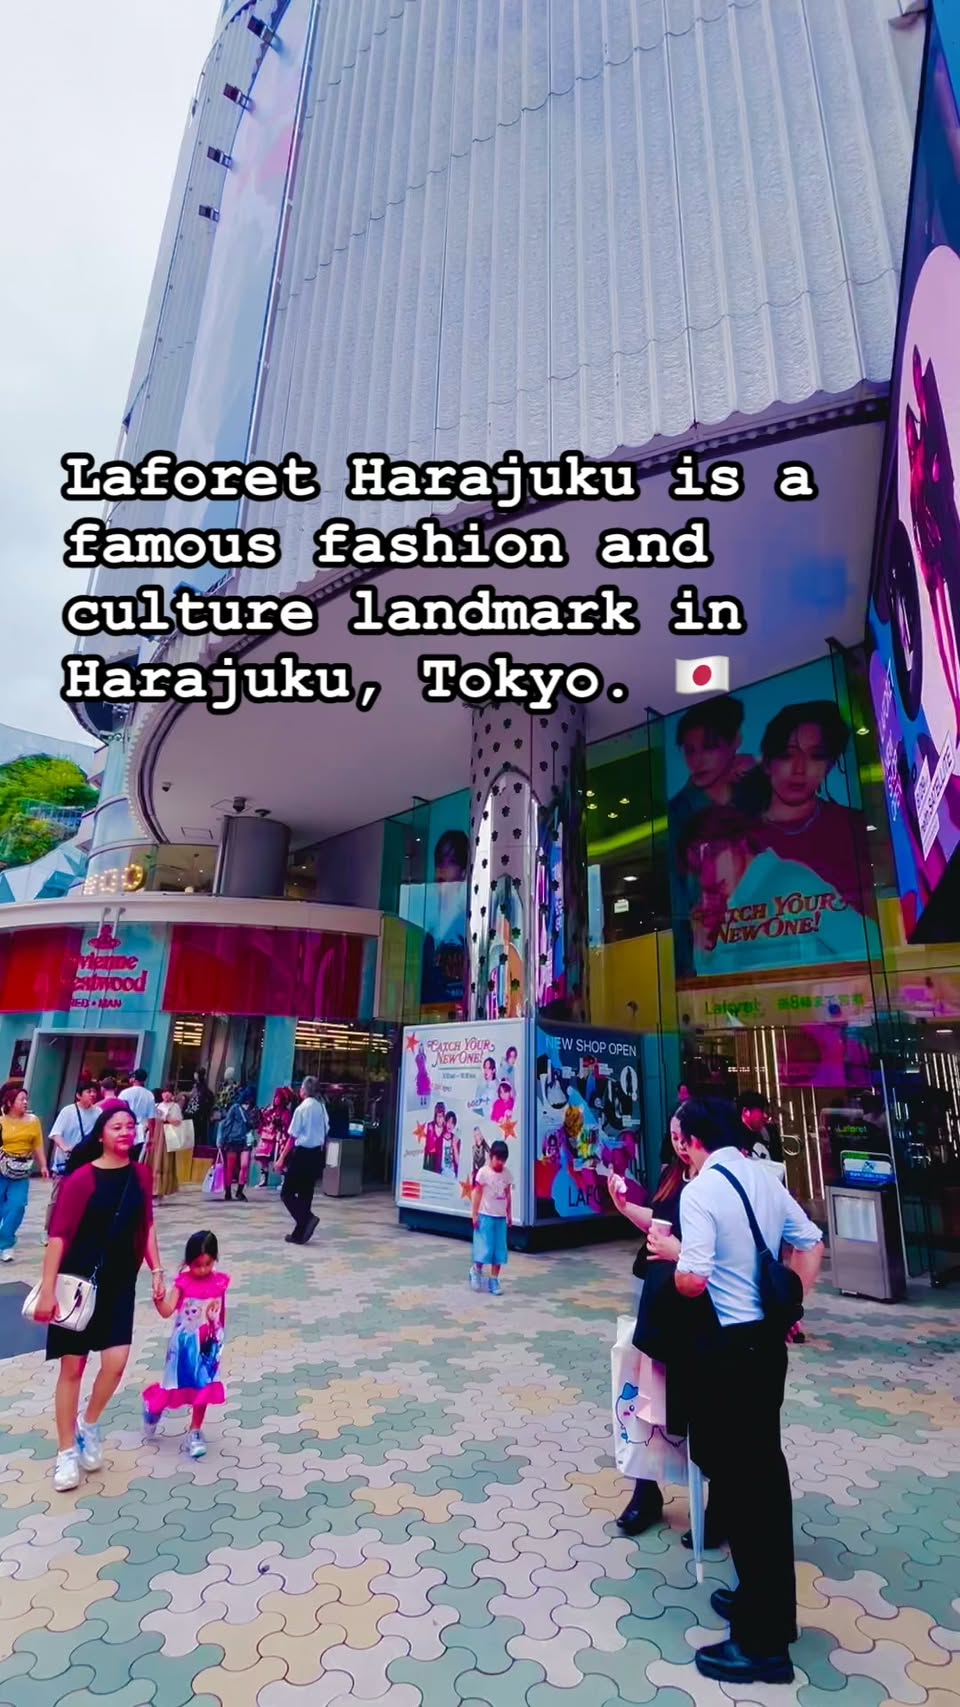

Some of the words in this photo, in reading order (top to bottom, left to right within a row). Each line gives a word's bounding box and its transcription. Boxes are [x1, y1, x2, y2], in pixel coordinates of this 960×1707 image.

[427, 1039, 461, 1053] CATCH
[464, 1036, 496, 1053] YOUR
[545, 1036, 573, 1051] NEW
[576, 1038, 607, 1054] SHOP
[608, 1042, 637, 1057] OPEN
[431, 1051, 458, 1068] NEW
[458, 1050, 484, 1065] ONE!
